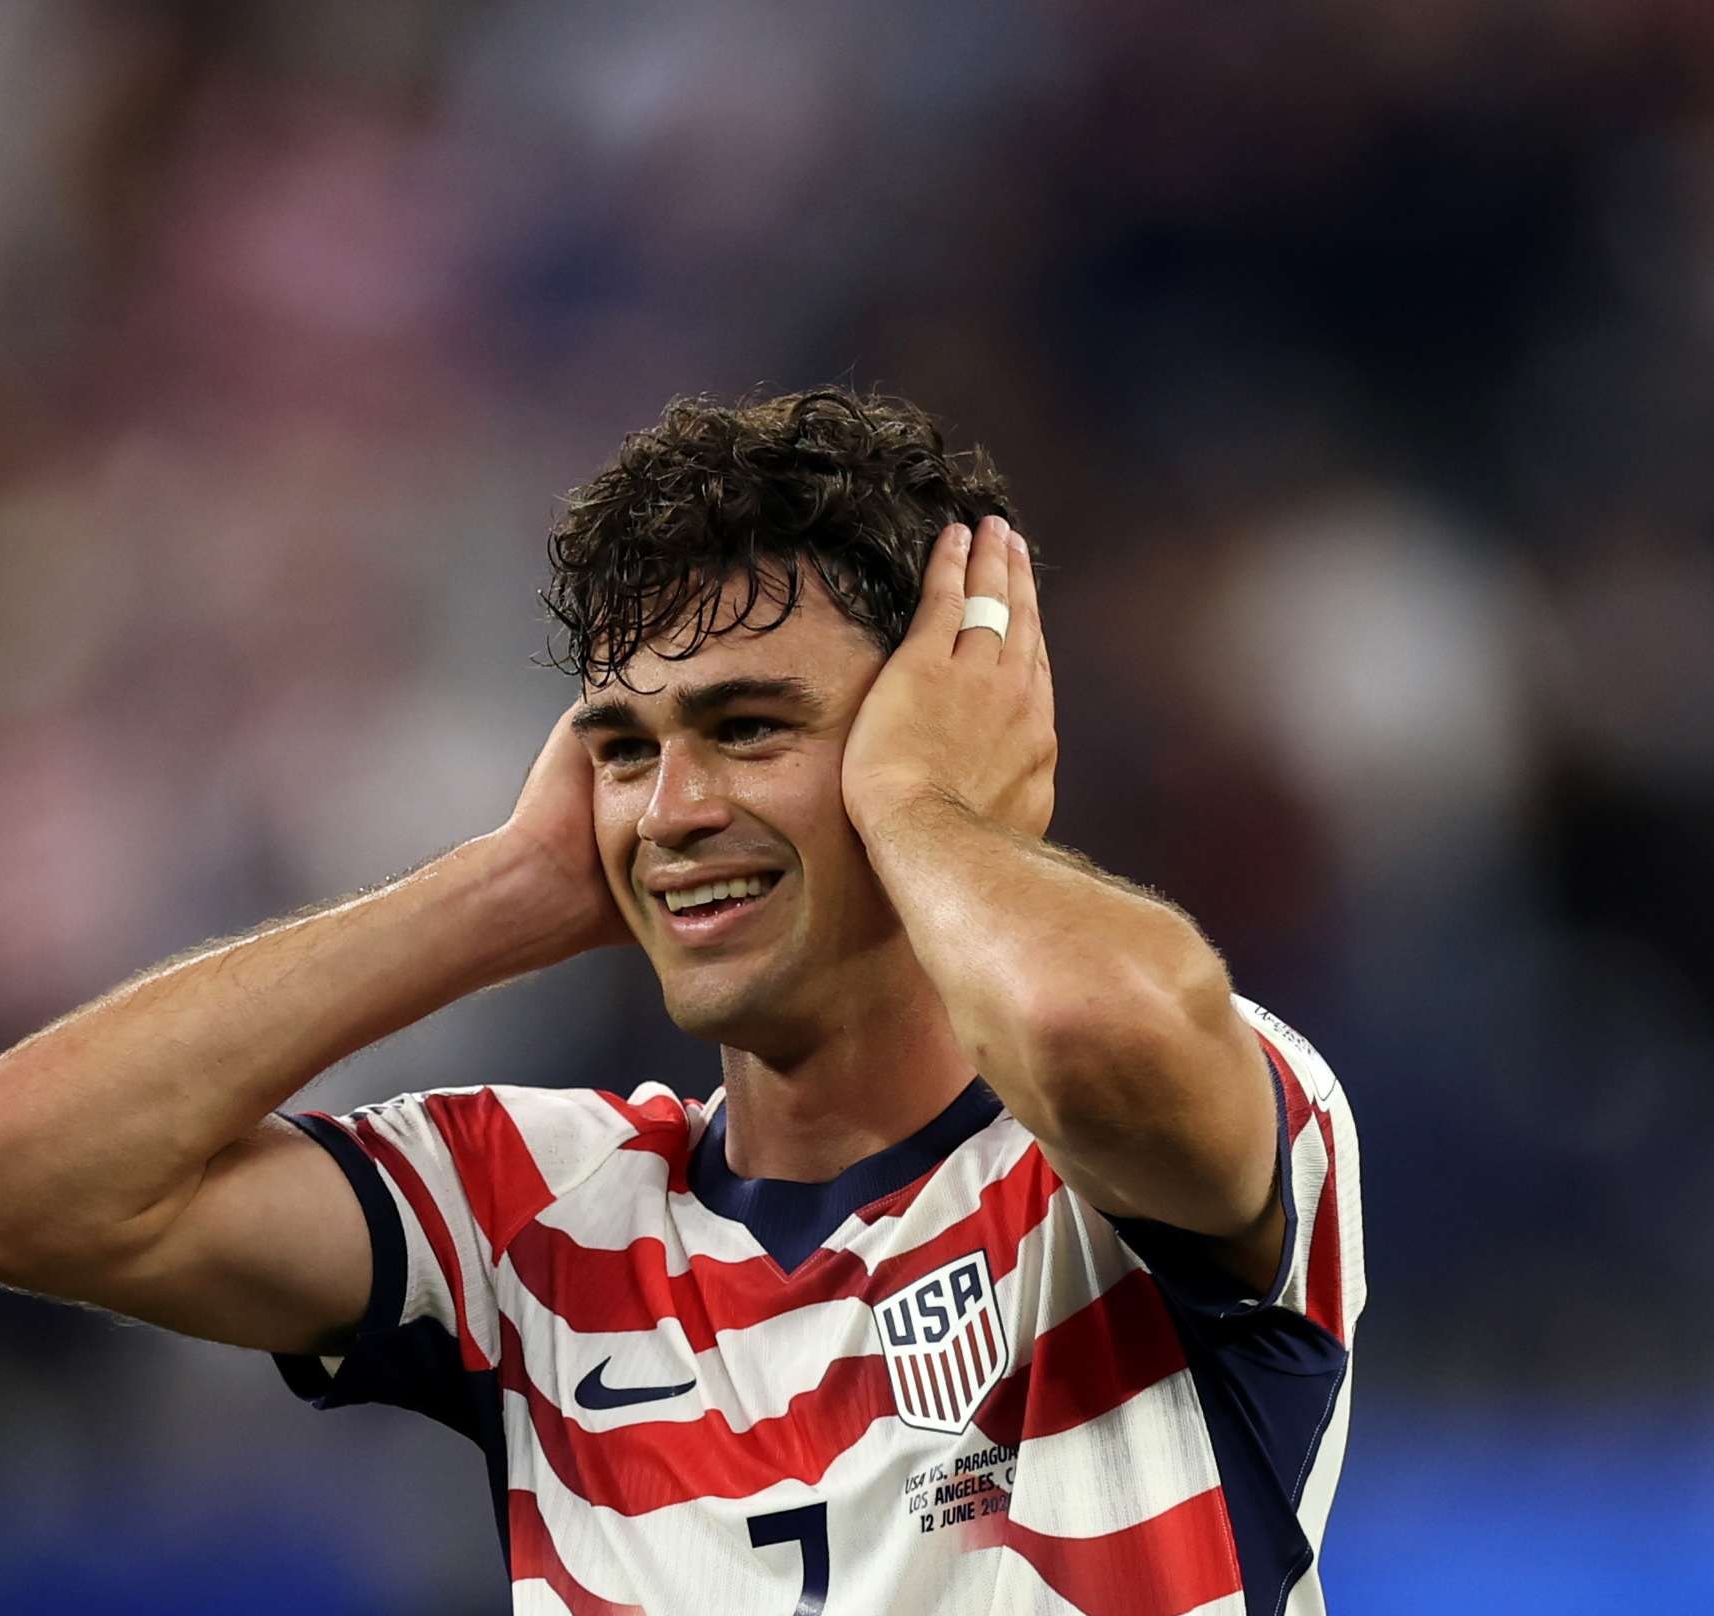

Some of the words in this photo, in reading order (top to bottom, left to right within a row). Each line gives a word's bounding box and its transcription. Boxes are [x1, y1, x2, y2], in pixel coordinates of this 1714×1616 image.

[882, 1261, 984, 1347] USA
[905, 1472, 926, 1494] USA
[929, 1463, 948, 1483] VS.
[955, 1445, 1020, 1477] PARAGUA
[909, 1491, 929, 1514] LOS
[920, 1514, 935, 1533] 12
[940, 1501, 976, 1528] JUNE
[981, 1492, 1012, 1517] 202
